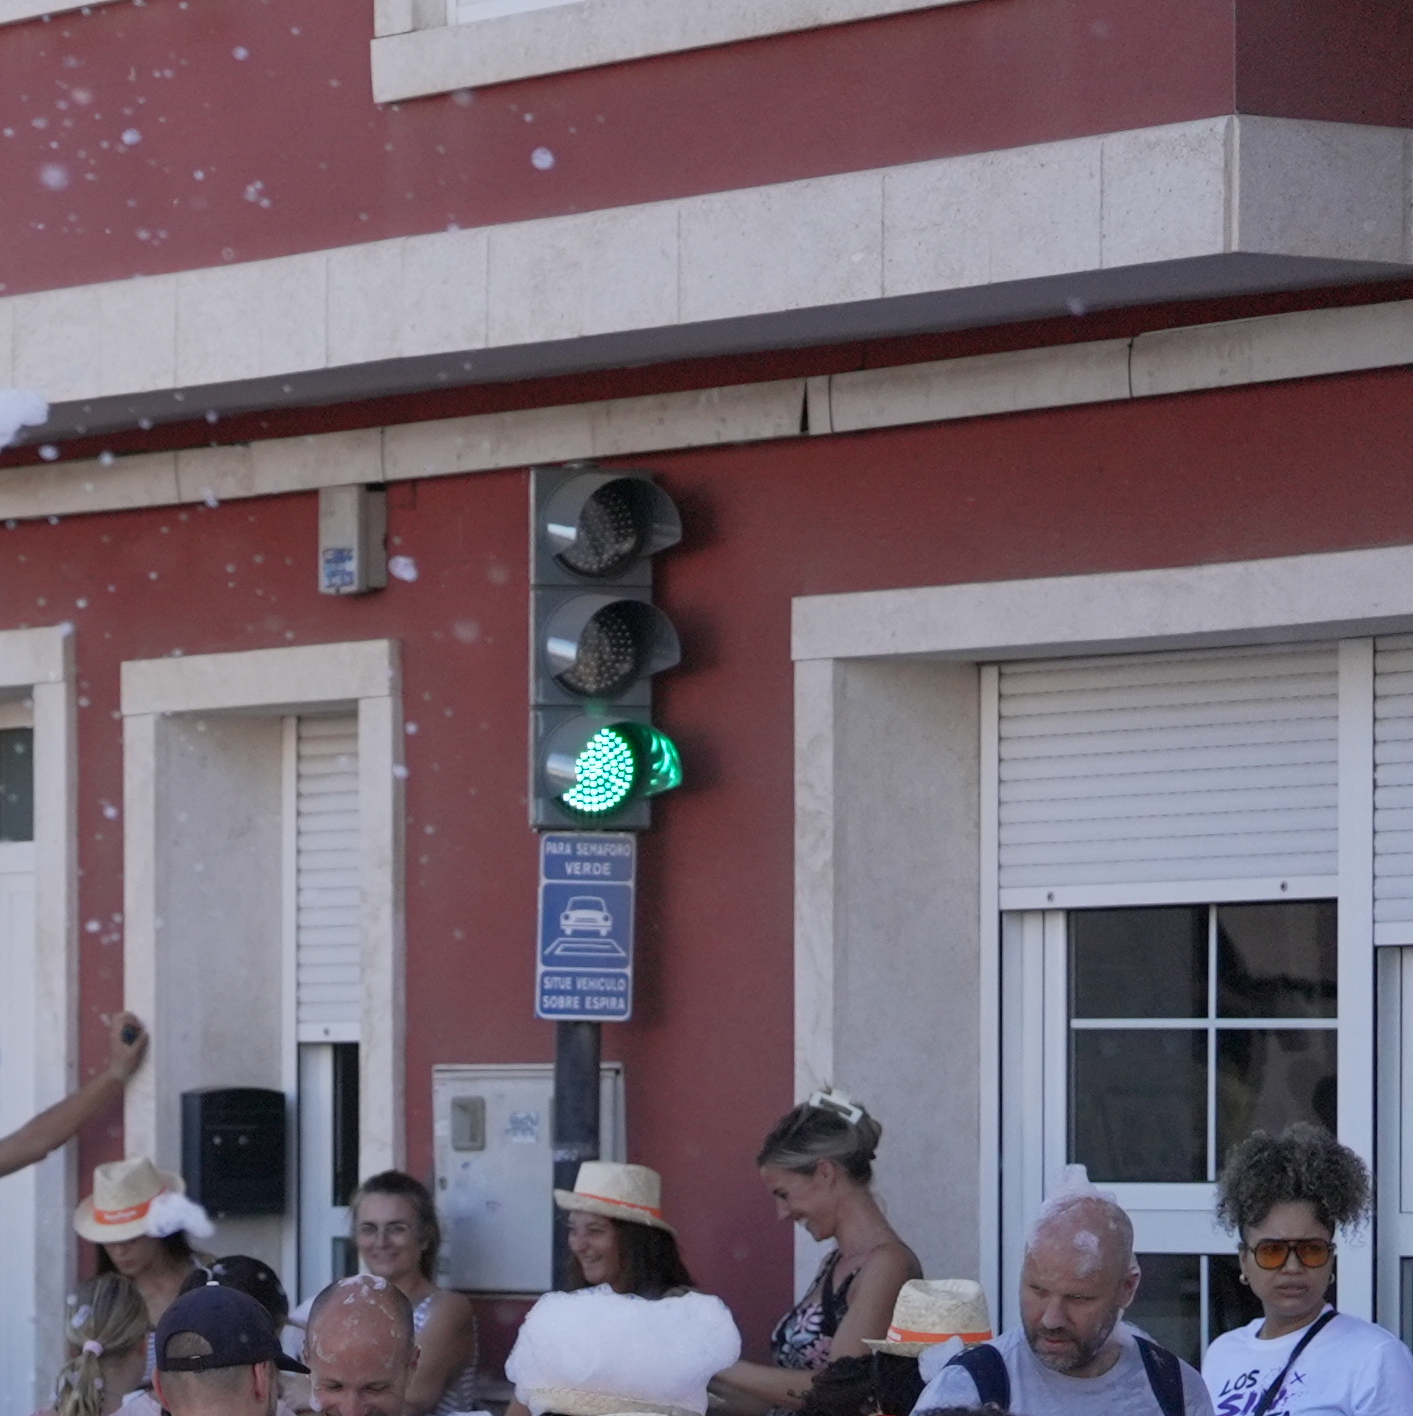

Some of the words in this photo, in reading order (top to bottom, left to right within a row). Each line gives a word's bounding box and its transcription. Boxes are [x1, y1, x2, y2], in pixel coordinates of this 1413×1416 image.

[545, 841, 572, 855] PARA
[575, 842, 632, 857] SEMAFORO
[564, 861, 612, 876] VERDE
[543, 976, 573, 990] SITUE
[542, 995, 581, 1010] SOBRE
[584, 996, 626, 1010] ESPIRA
[1218, 1369, 1260, 1397] LOS
